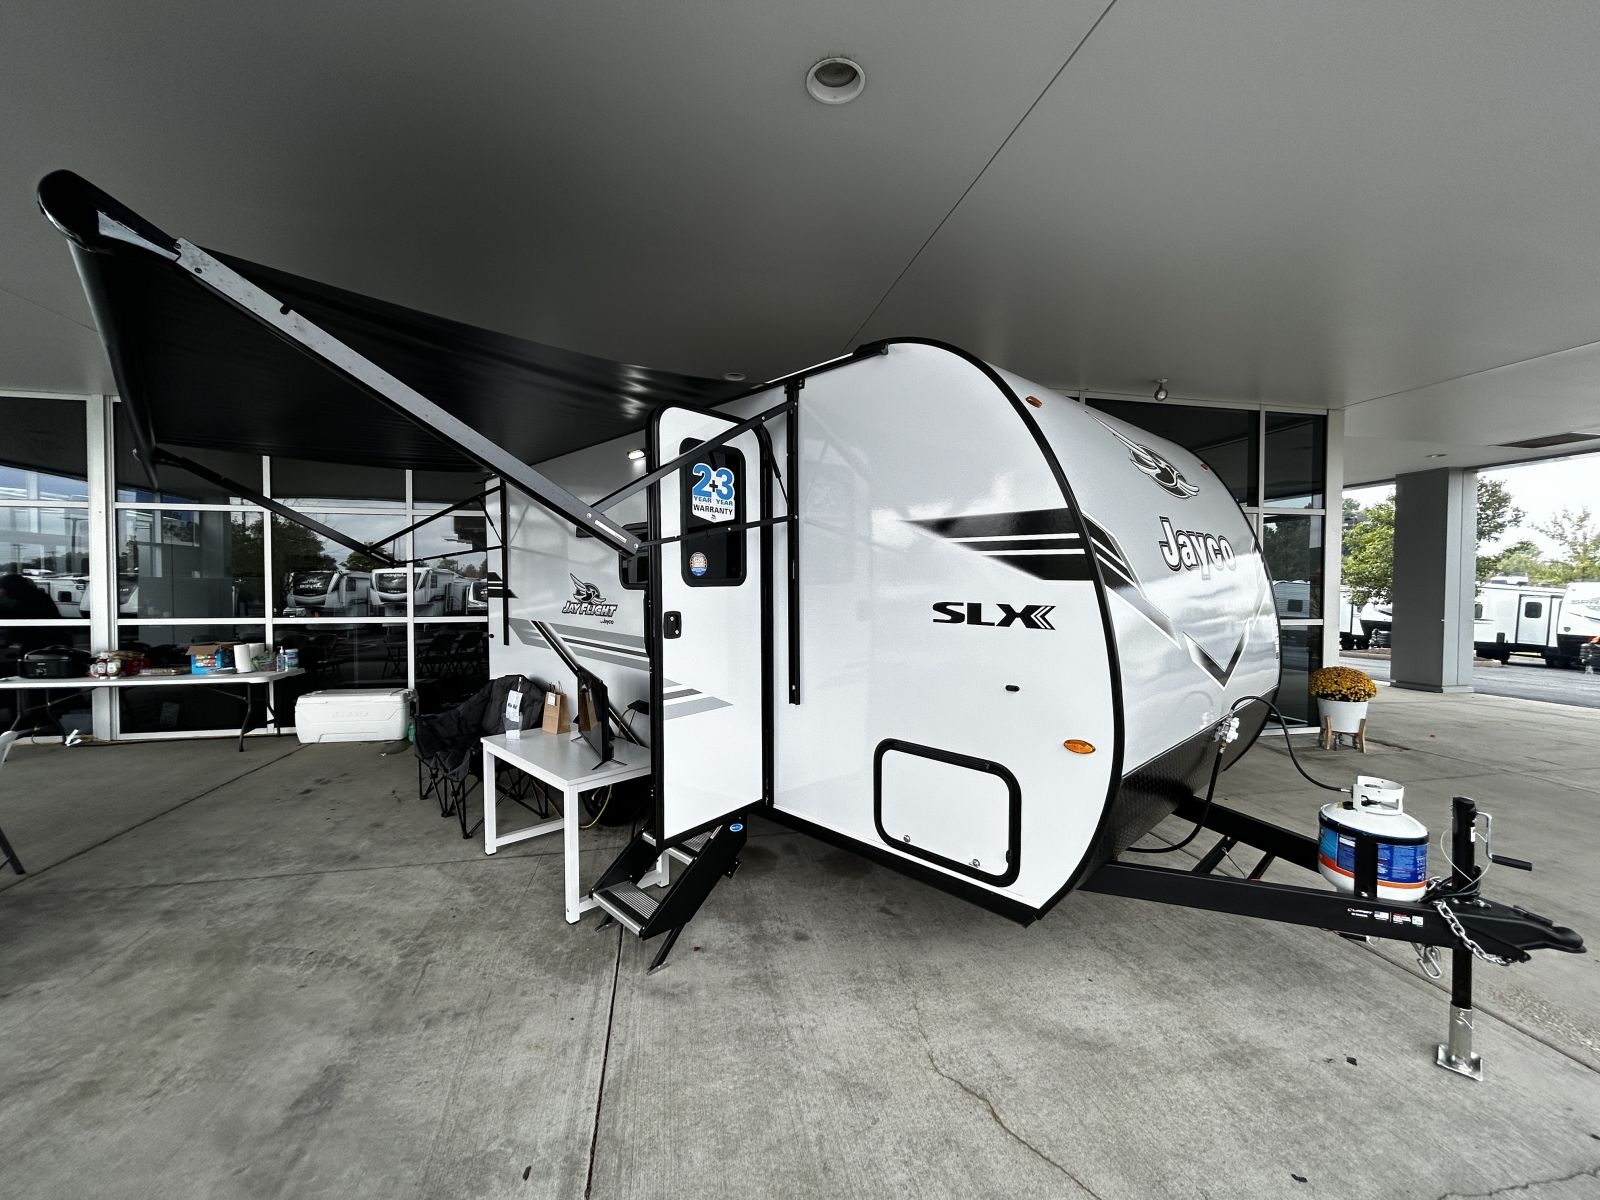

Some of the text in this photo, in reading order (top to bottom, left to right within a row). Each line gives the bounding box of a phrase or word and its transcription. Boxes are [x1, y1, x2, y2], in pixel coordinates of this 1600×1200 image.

[693, 495, 733, 506] YEAR YEAR
[693, 503, 733, 516] WARRANTY
[1159, 515, 1236, 580] Jayco
[562, 600, 618, 617] JAY FLIGHT
[932, 601, 1056, 631] SLX
